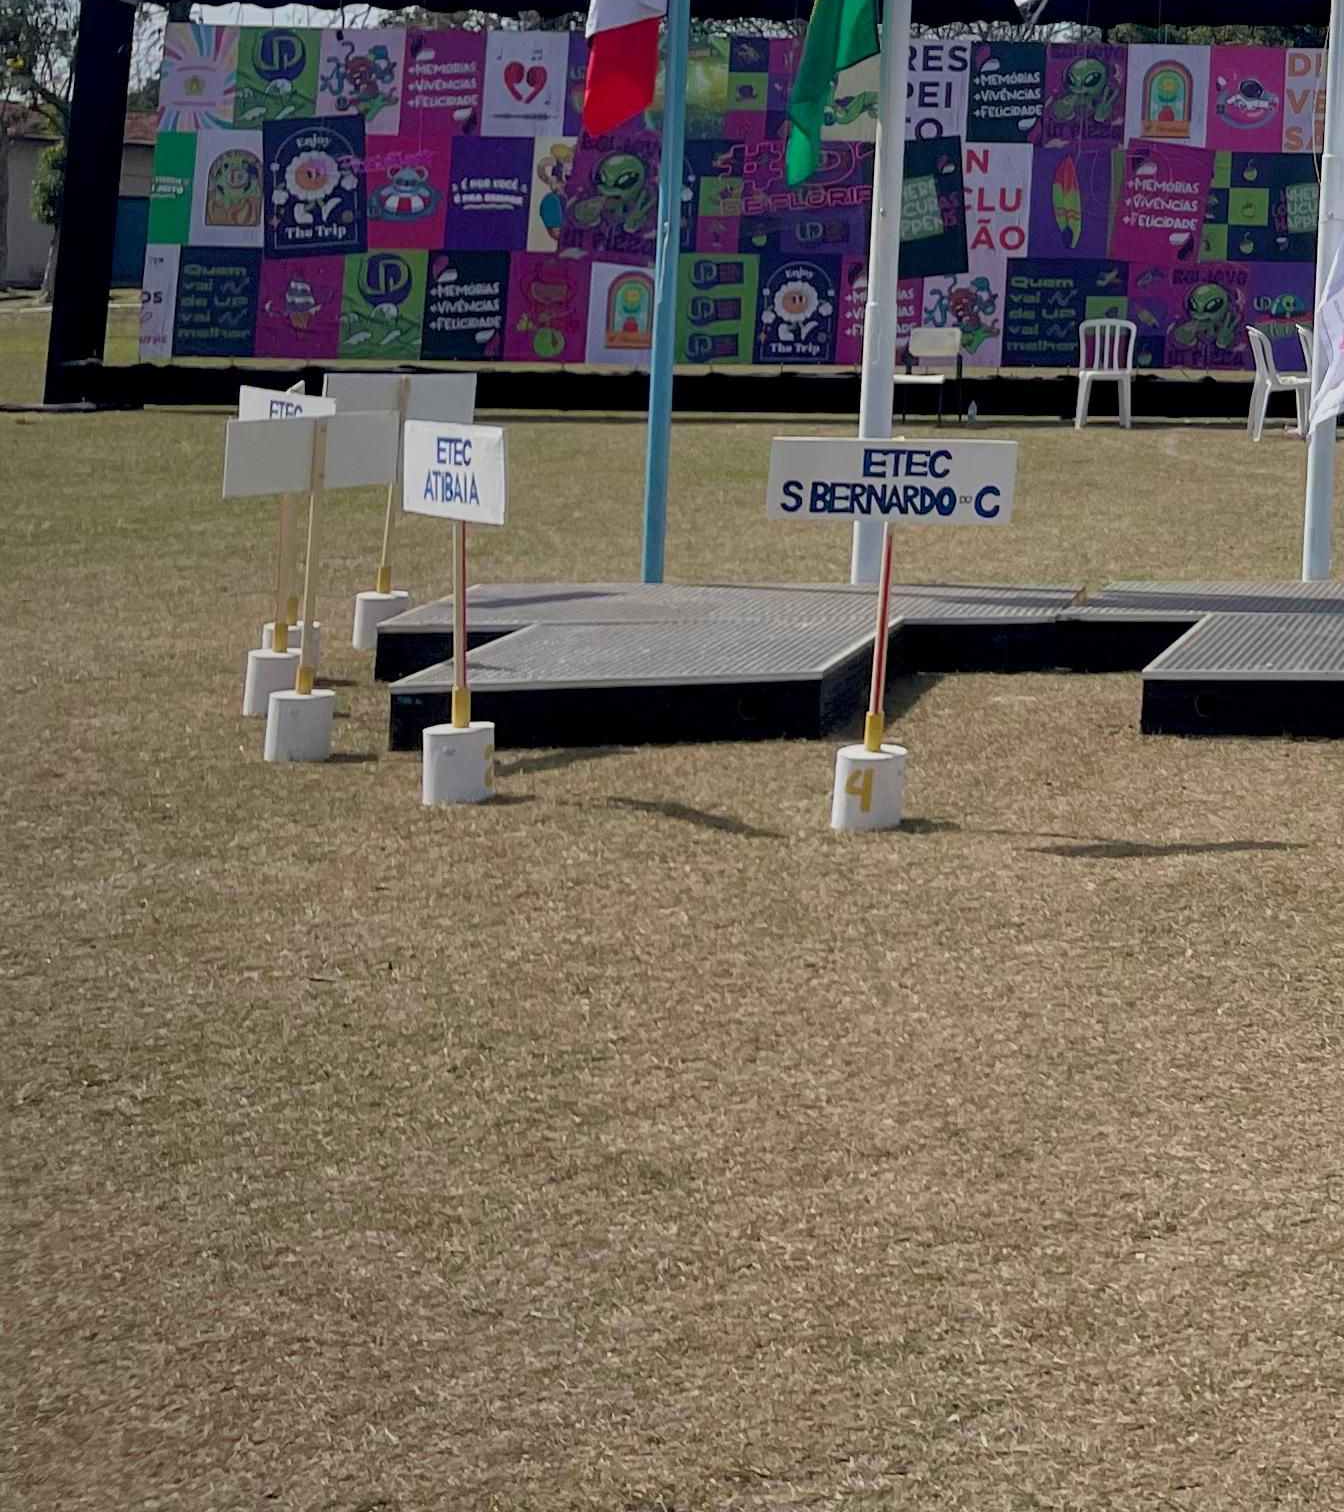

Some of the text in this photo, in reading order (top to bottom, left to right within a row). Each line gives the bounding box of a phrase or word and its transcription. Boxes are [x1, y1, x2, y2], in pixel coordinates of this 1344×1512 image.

[906, 117, 943, 139] O
[966, 149, 989, 173] N
[286, 225, 347, 240] The Trip
[970, 218, 1025, 251] ÃO
[1011, 276, 1074, 288] Quem
[1010, 291, 1040, 303] vai
[1042, 308, 1076, 320] UP
[1008, 323, 1039, 336] vai
[769, 341, 820, 356] The Trip
[1007, 339, 1077, 352] melhor
[436, 436, 473, 467] ETEC
[862, 448, 952, 479] ETEC
[424, 470, 480, 506] ATIBAIA
[780, 480, 804, 513] S
[809, 481, 957, 517] BERNARDO
[974, 485, 1001, 518] C
